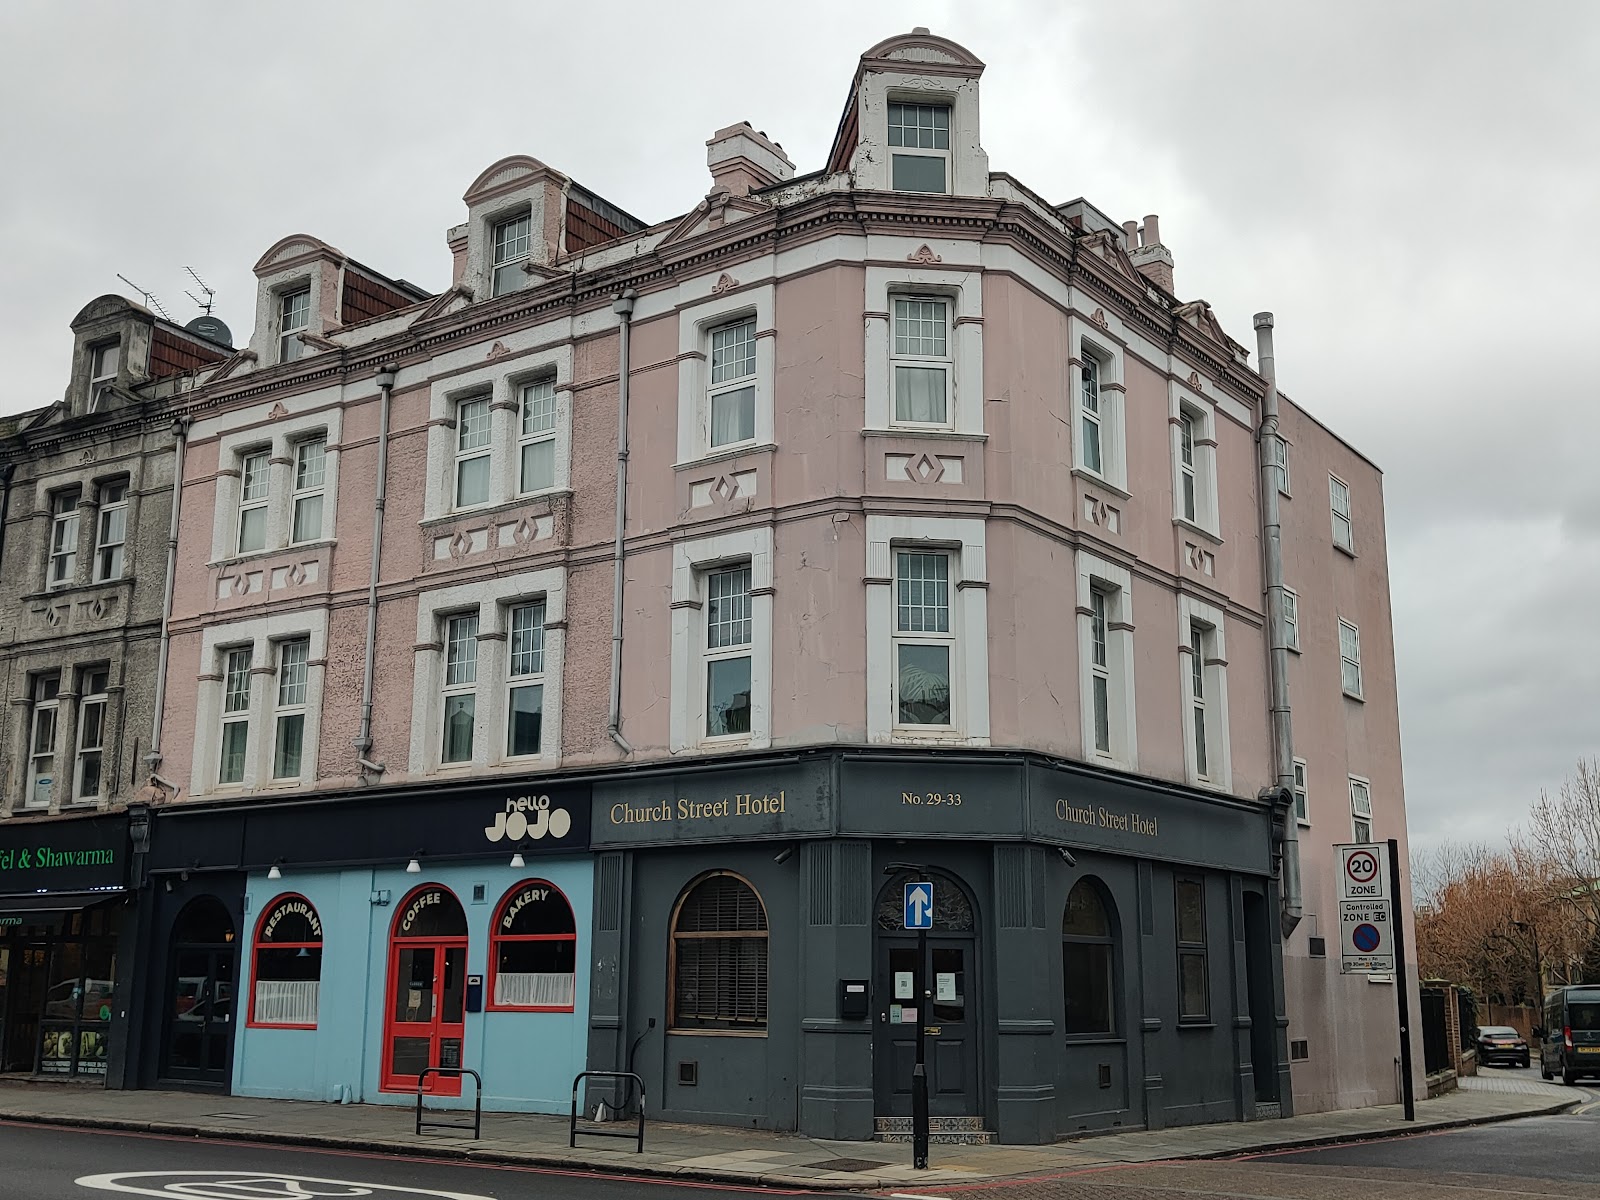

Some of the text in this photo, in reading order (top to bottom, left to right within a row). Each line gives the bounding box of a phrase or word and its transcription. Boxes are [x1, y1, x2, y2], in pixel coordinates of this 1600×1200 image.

[505, 794, 550, 813] hello
[610, 790, 786, 824] Church Street Hotel
[901, 792, 962, 806] No. 29-33
[484, 808, 571, 842] JOJO
[1055, 799, 1158, 837] Church Street Hotel
[18, 848, 31, 869] &
[36, 847, 114, 869] Shawarma
[1352, 860, 1372, 873] 20
[1351, 886, 1376, 894] ZONE
[264, 901, 321, 938] RESTAURANT
[402, 892, 441, 931] COFFEE
[502, 889, 550, 929] BAKERY
[1374, 912, 1386, 921] EC
[0, 917, 23, 925] rma
